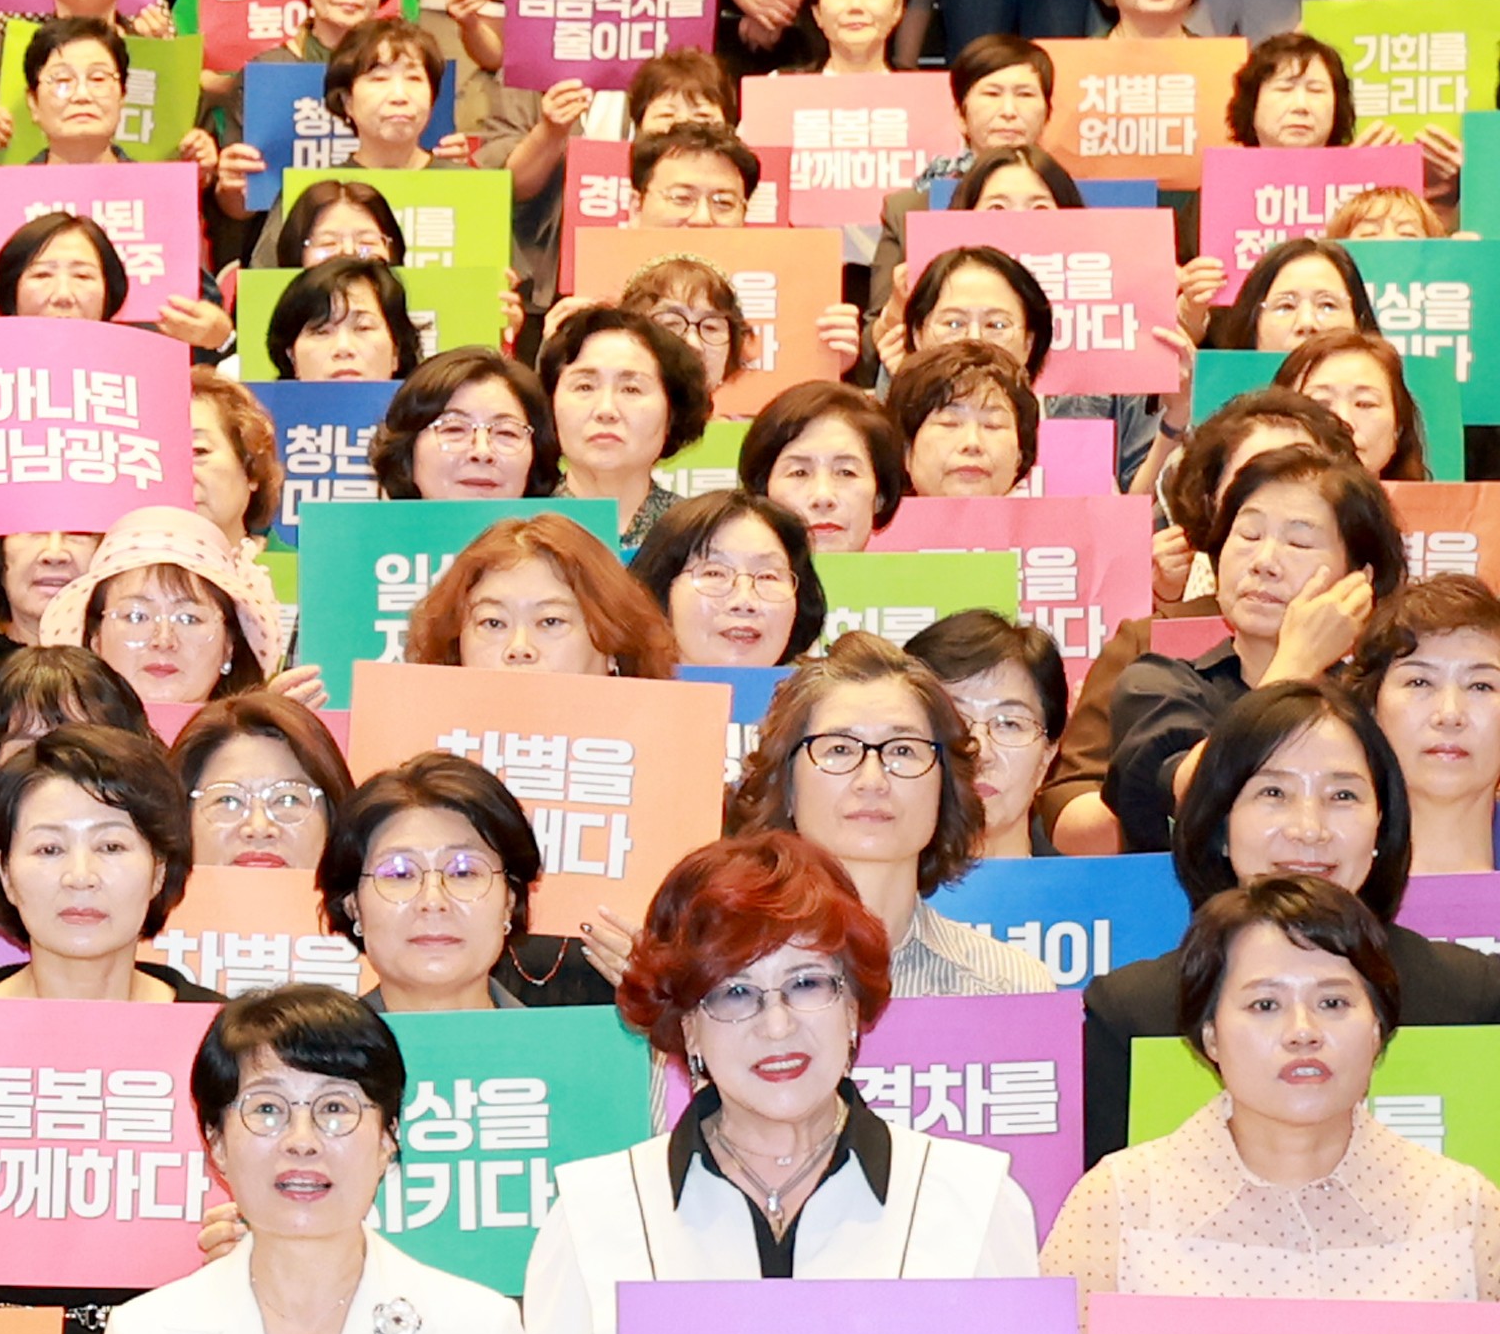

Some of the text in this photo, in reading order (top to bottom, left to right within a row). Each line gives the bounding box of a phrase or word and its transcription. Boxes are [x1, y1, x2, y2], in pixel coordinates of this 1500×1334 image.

[554, 21, 668, 60] 줄이다
[1354, 33, 1467, 72] 기회를
[1080, 75, 1195, 113] 차별을
[1353, 76, 1469, 116] 늘리다
[795, 110, 906, 147] 돌봄을
[1080, 117, 1197, 155] 없애다
[404, 1078, 549, 1151] 상을
